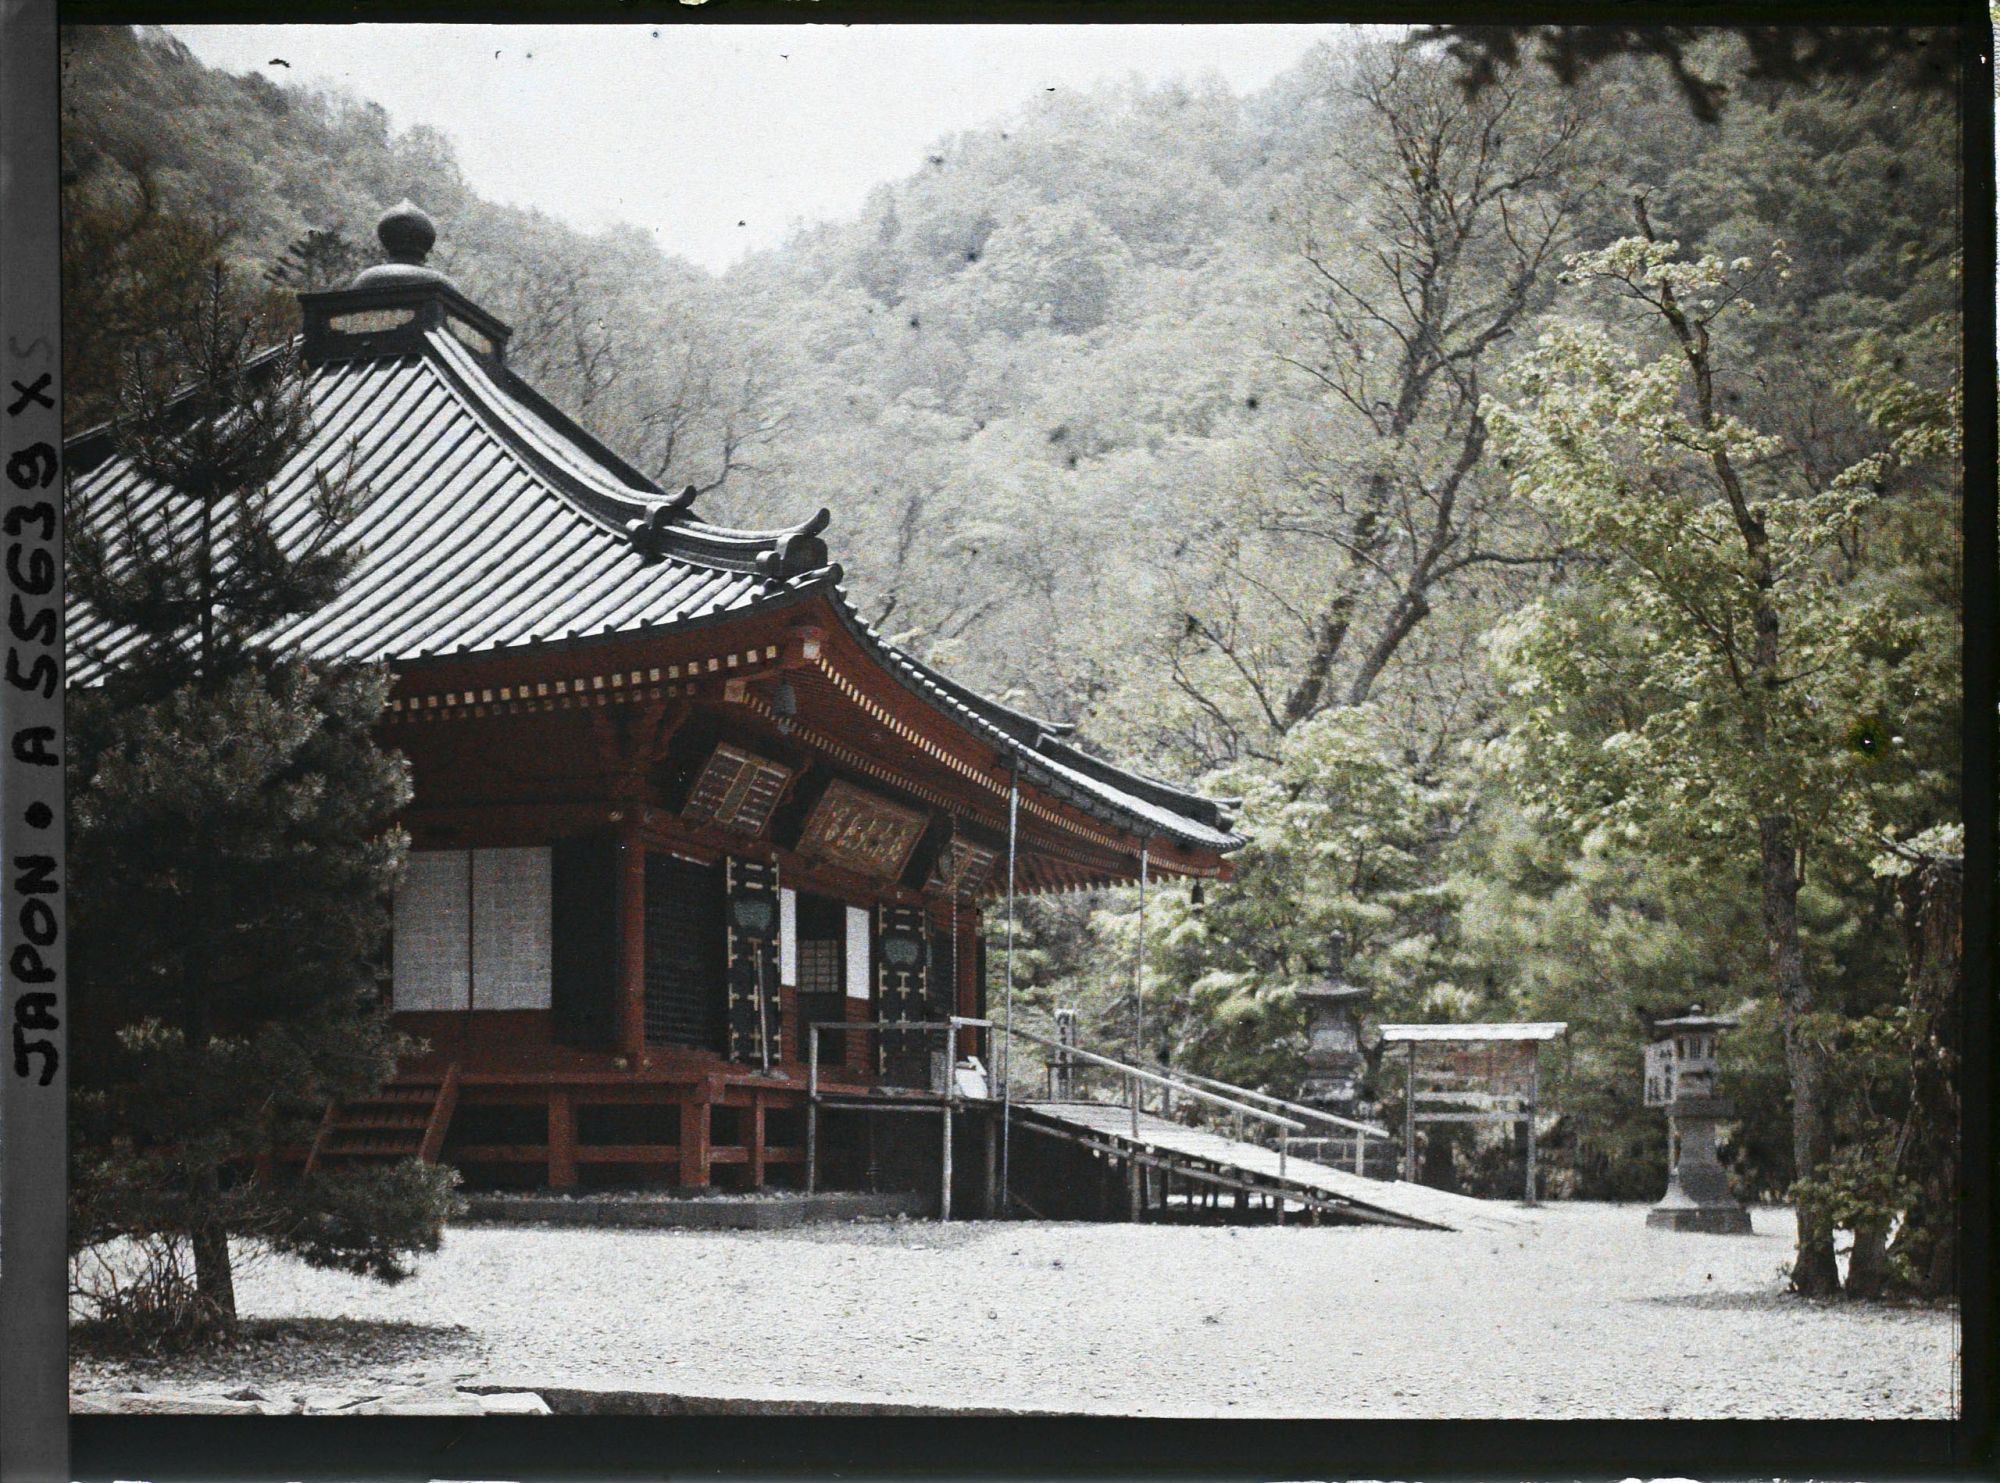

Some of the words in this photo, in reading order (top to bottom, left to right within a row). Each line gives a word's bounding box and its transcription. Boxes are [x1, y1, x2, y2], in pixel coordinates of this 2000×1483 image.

[4, 442, 56, 700] 55639
[11, 726, 56, 767] A
[10, 855, 56, 1086] JAPON
